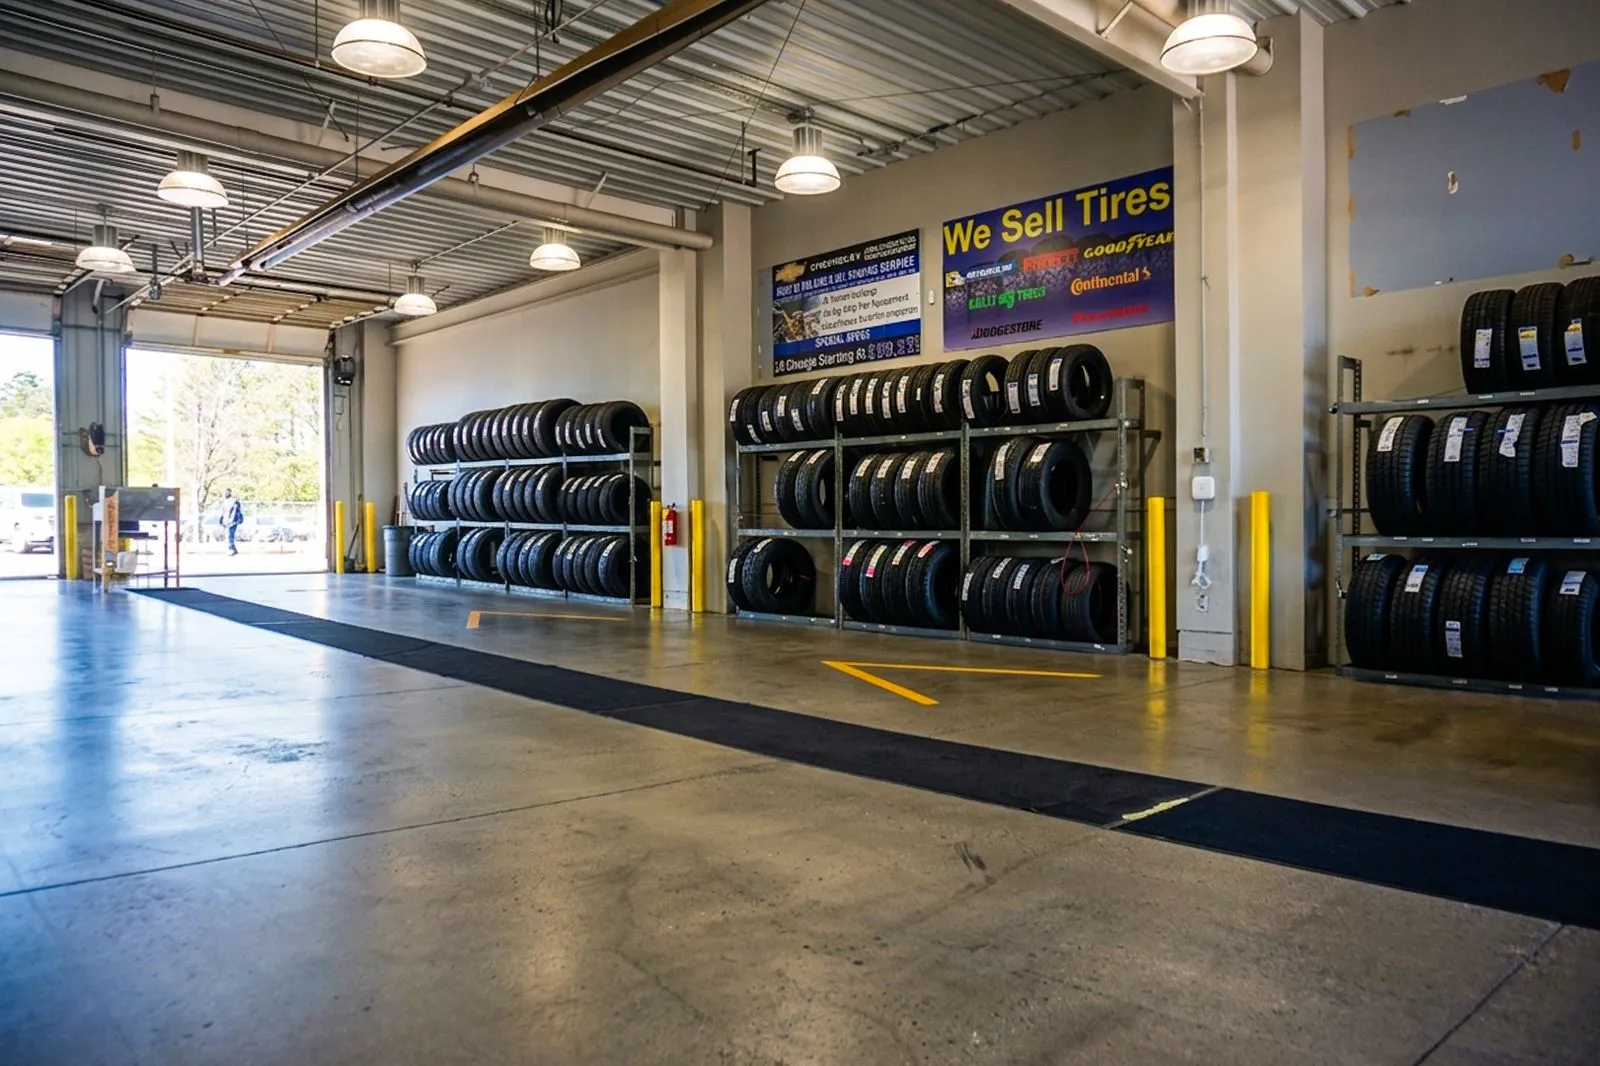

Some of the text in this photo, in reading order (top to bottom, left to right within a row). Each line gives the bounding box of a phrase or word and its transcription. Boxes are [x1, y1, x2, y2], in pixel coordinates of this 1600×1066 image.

[943, 219, 991, 256] We
[1001, 198, 1063, 243] Sell
[1076, 182, 1171, 226] Tires
